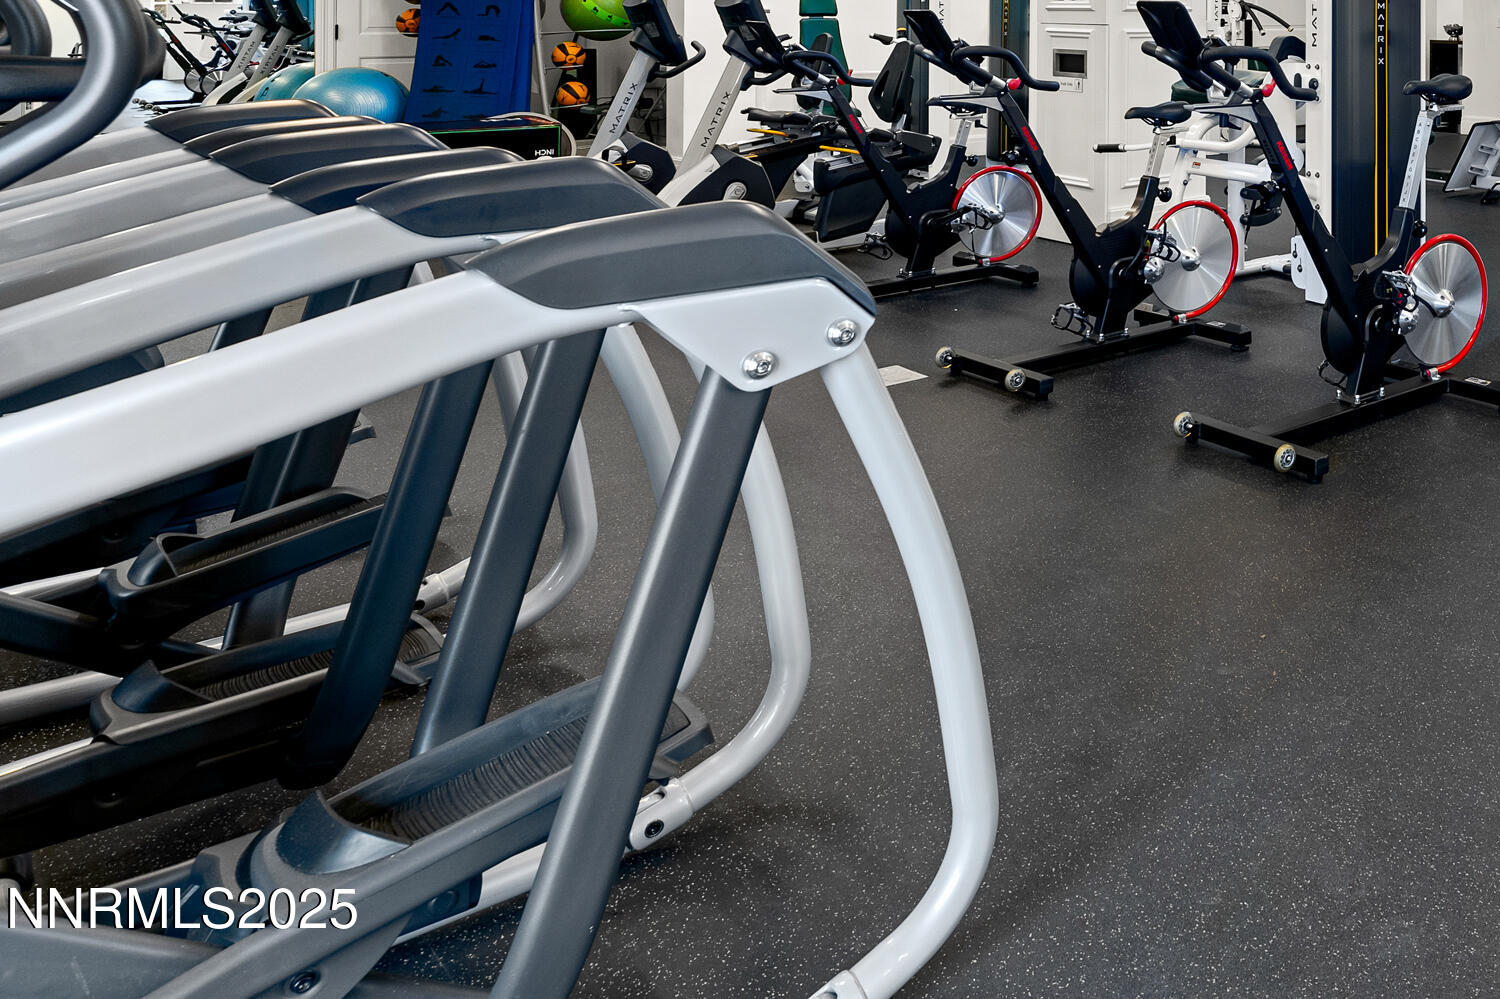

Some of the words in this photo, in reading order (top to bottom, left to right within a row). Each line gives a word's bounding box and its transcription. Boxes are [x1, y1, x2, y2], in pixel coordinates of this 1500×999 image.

[1377, 2, 1386, 65] MATRIX
[609, 82, 638, 134] MATRIX
[701, 92, 731, 148] MATRIX
